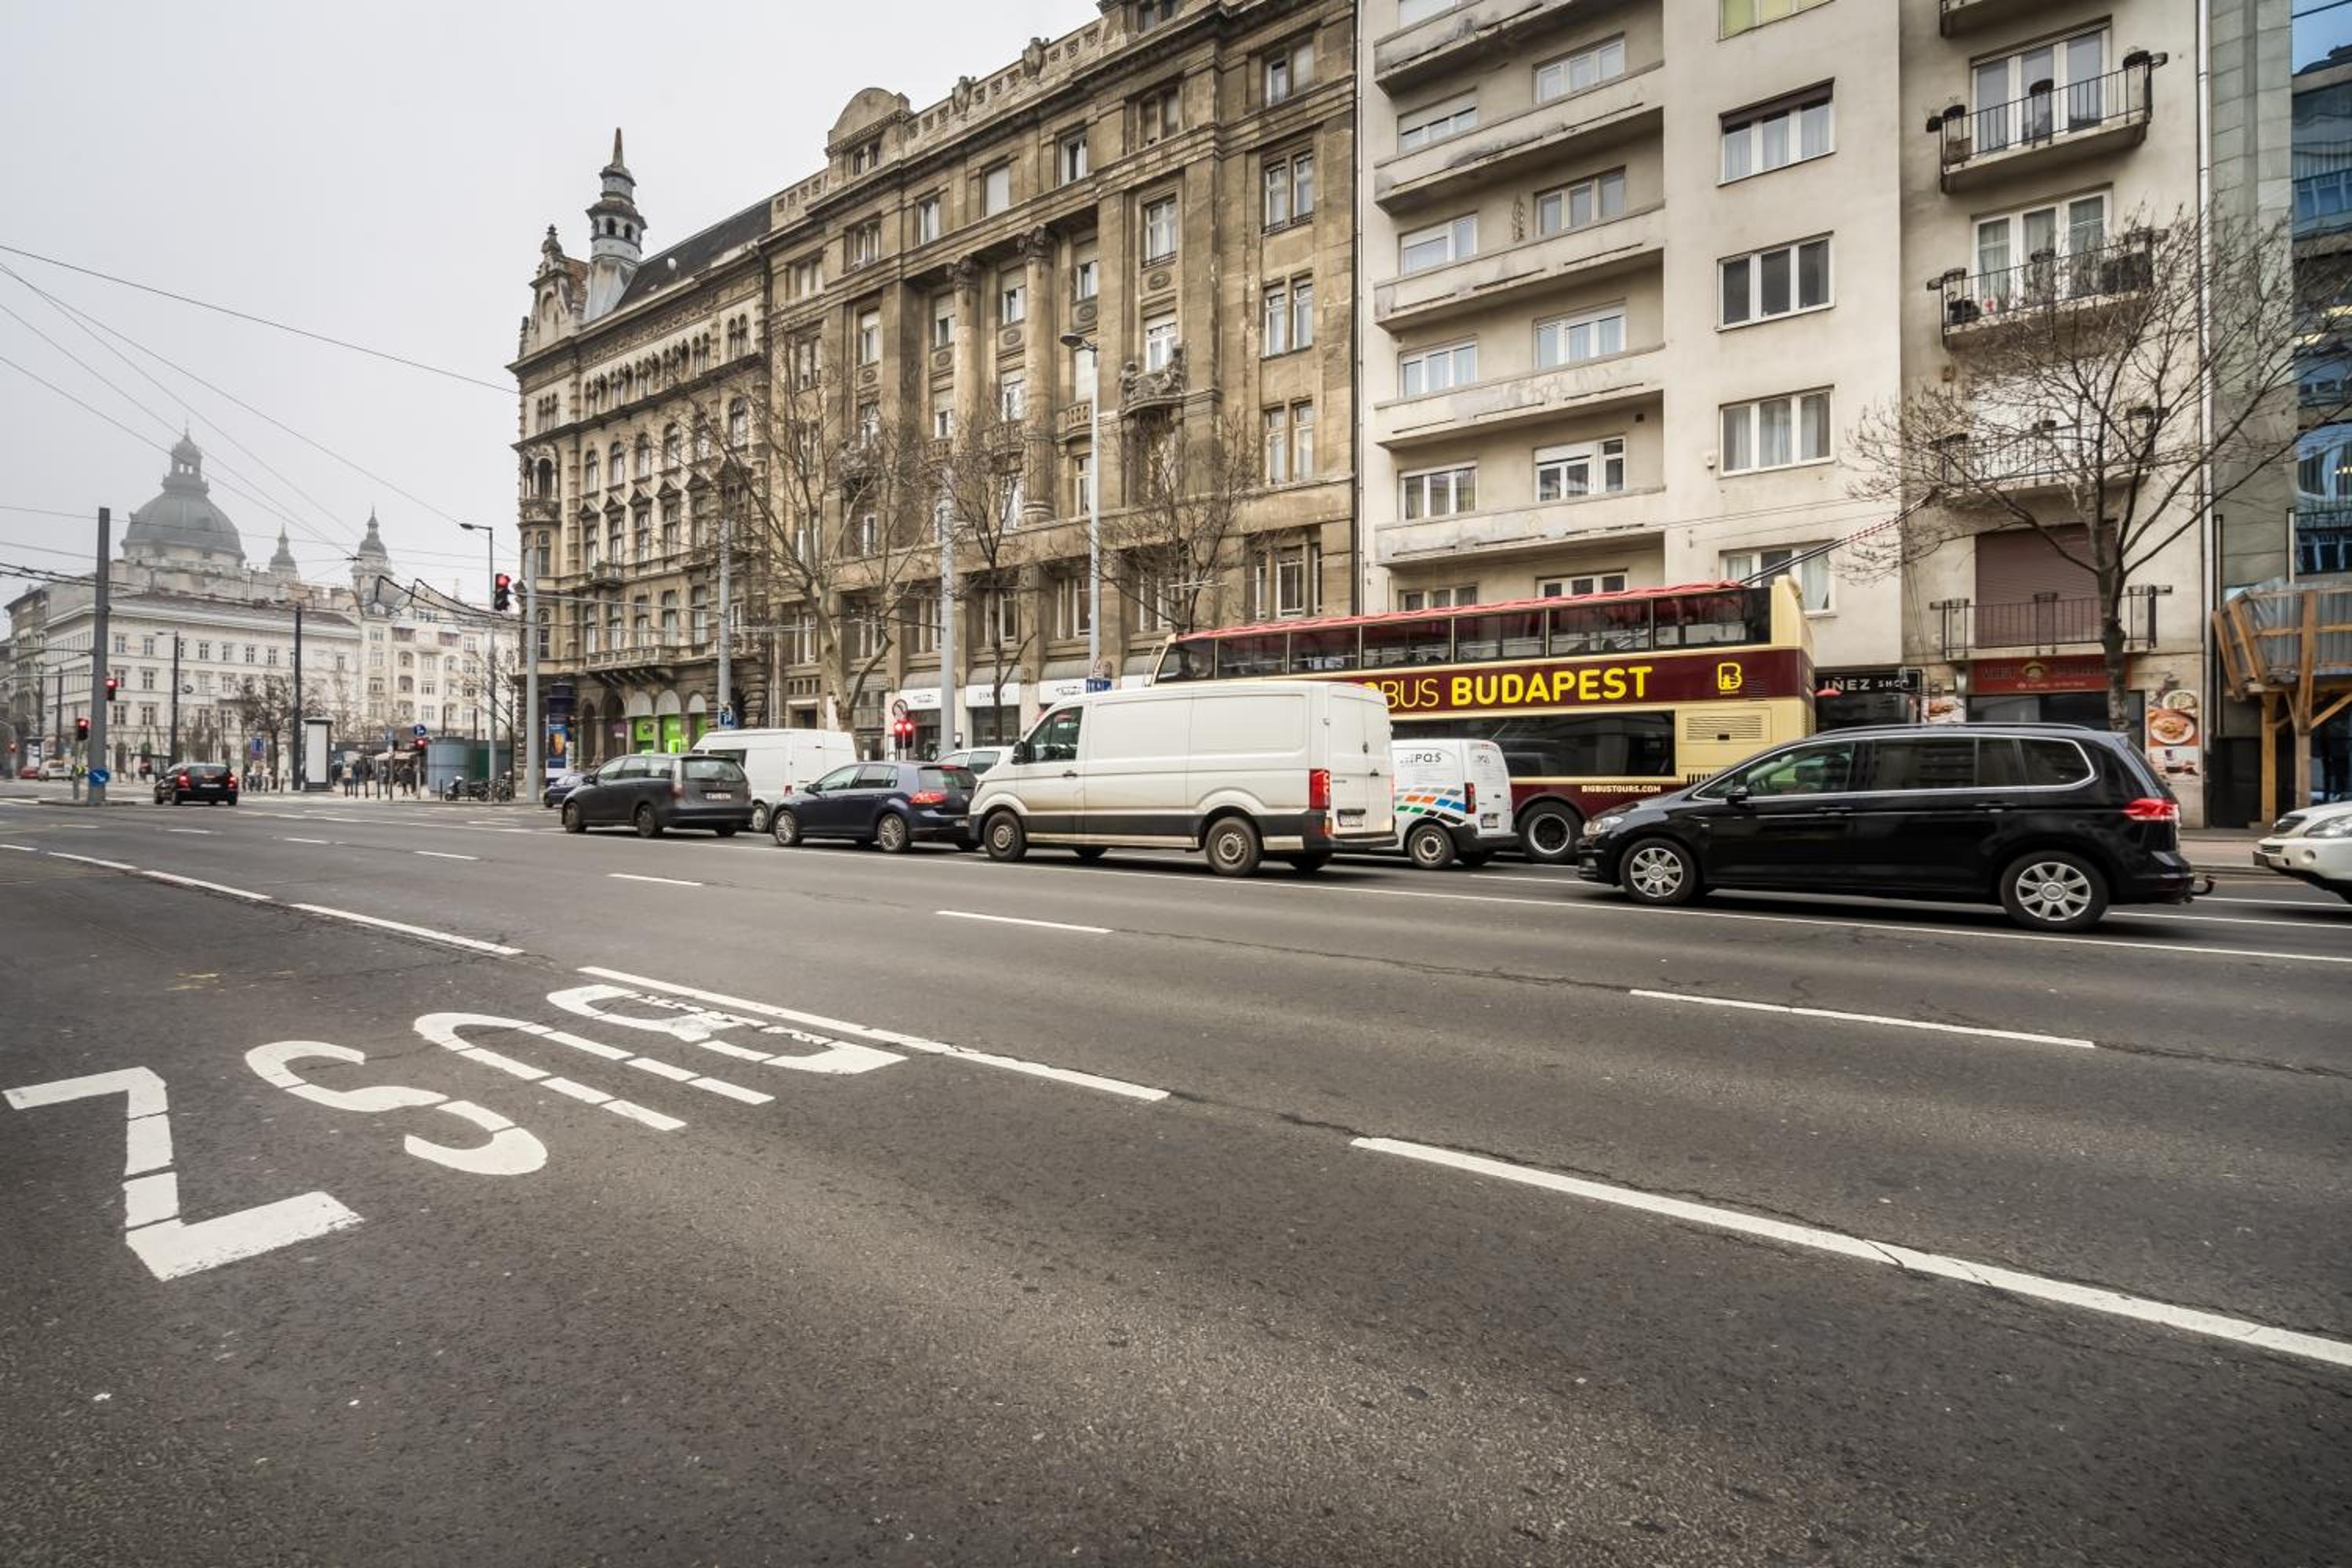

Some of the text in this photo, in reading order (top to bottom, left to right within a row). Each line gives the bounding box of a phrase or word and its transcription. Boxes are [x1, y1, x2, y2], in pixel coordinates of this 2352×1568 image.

[1363, 666, 1653, 710] BUS BUDAPEST
[1581, 785, 1661, 793] BIGBUSTOURS.COM
[3, 984, 909, 1281] BUSZ
